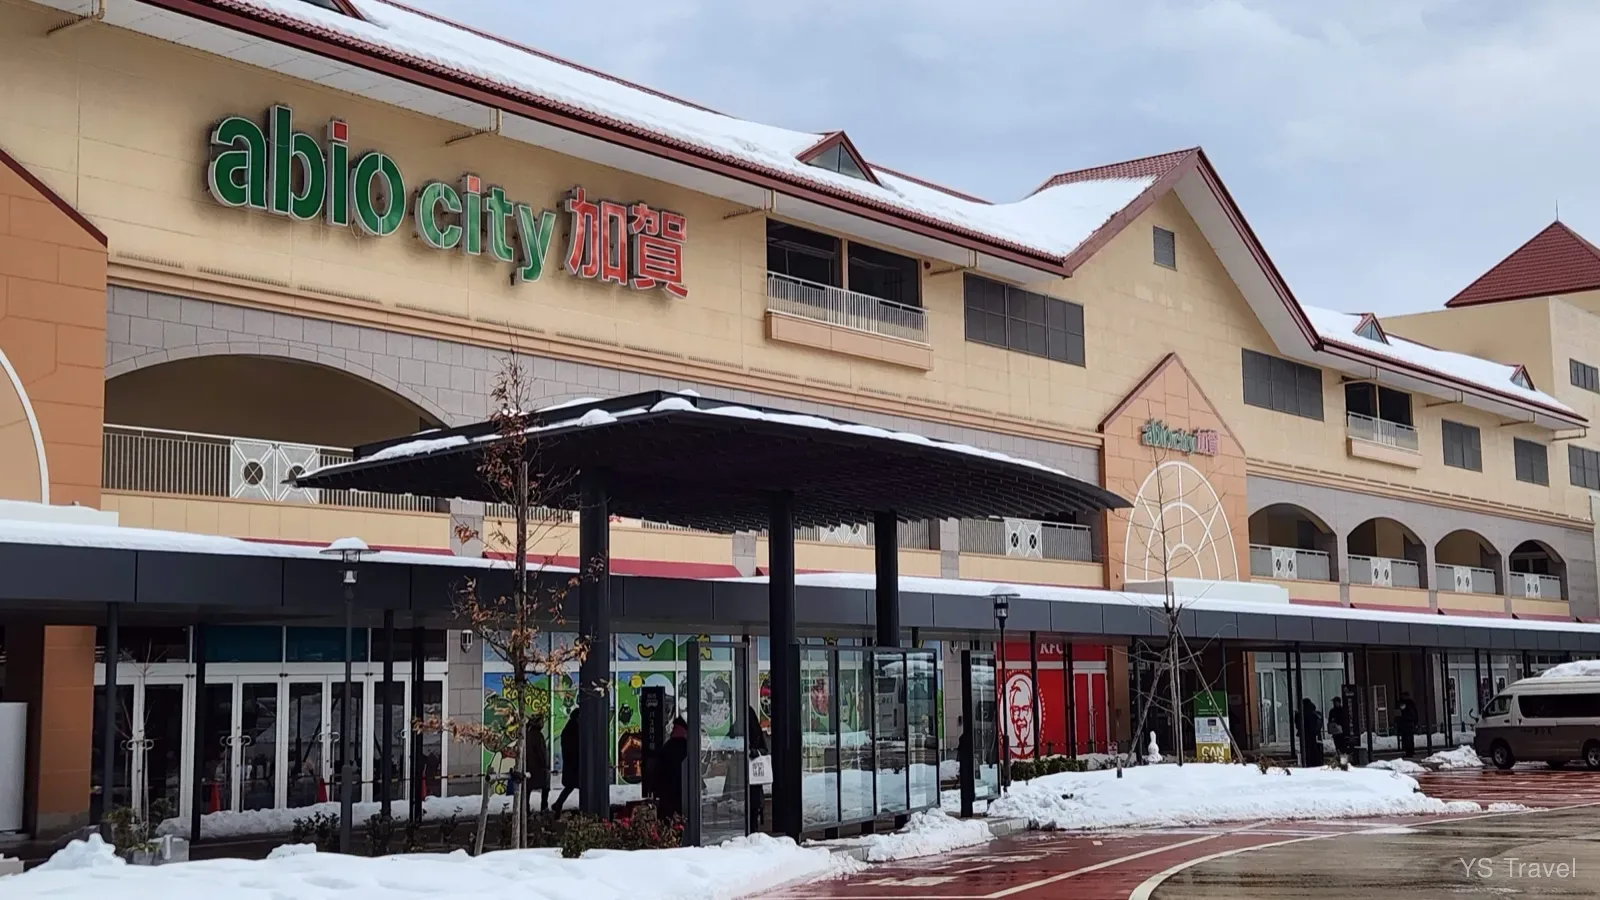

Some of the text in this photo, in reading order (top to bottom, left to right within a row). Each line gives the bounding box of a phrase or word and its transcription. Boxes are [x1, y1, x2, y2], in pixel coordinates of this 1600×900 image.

[207, 104, 690, 299] abio city 加賀
[1039, 643, 1063, 654] KFC
[1201, 745, 1225, 757] CAN
